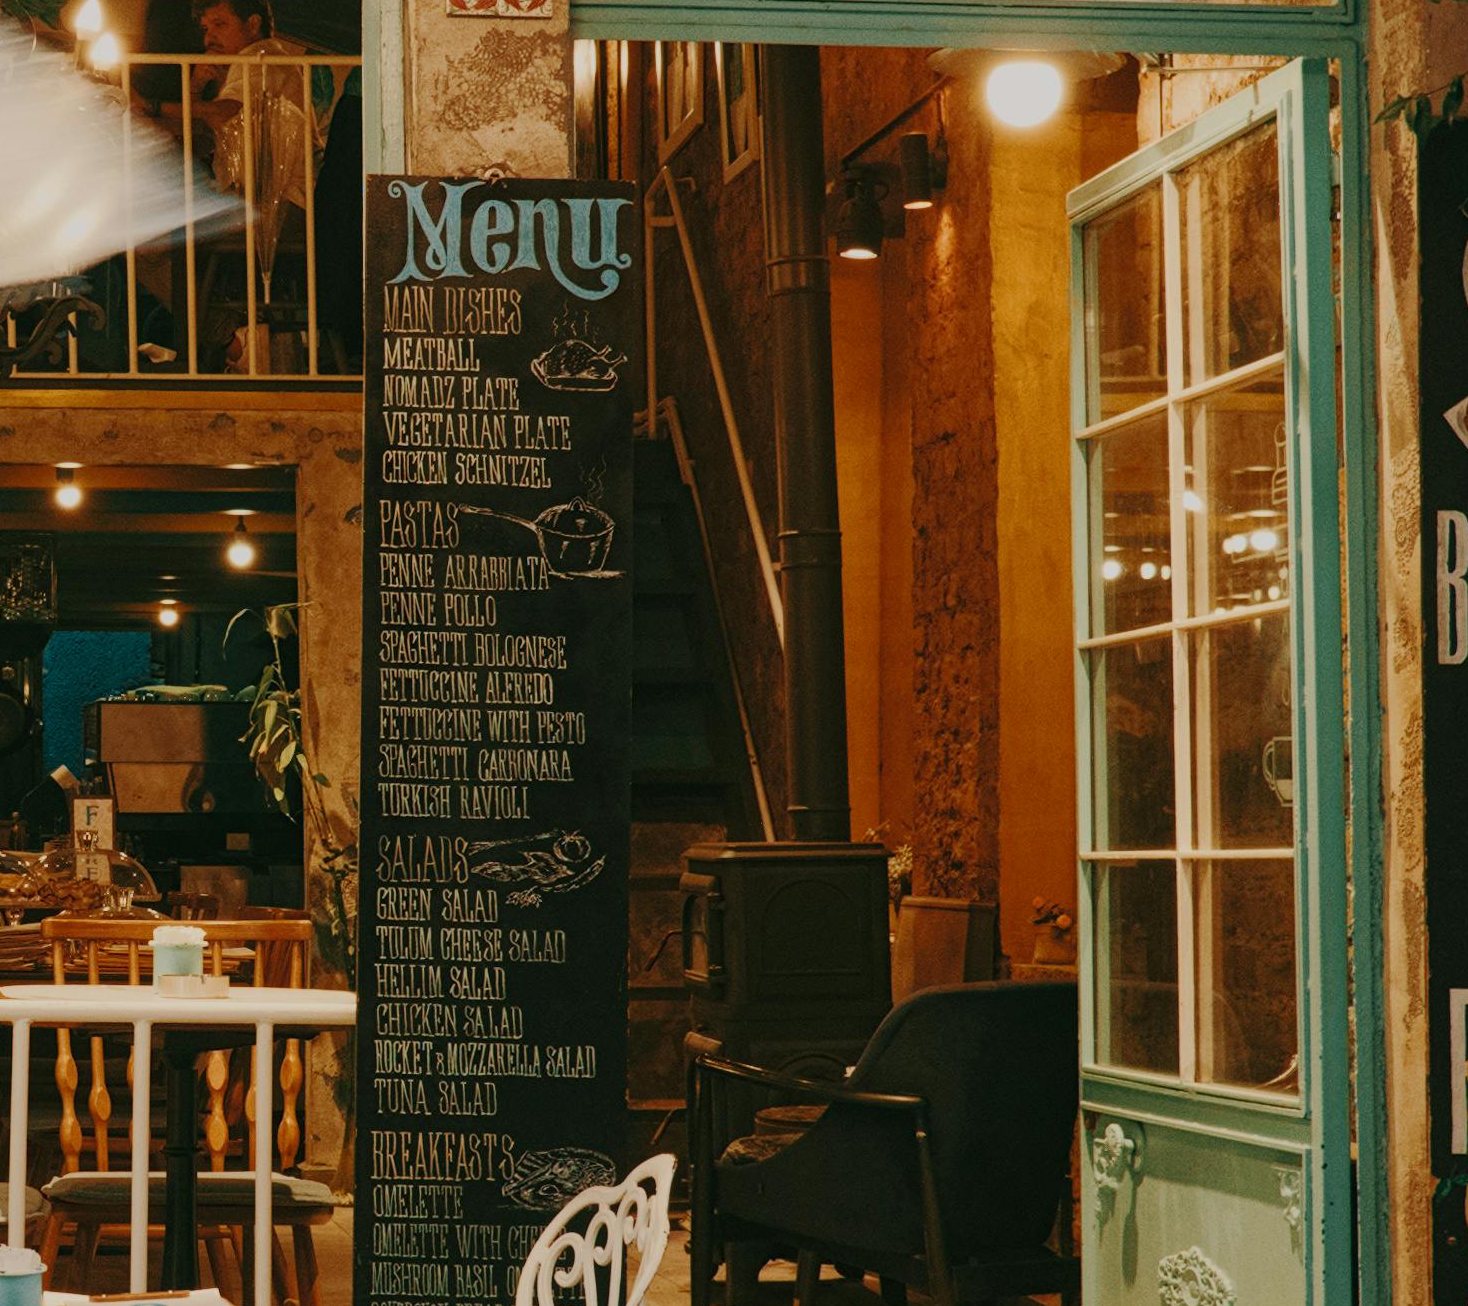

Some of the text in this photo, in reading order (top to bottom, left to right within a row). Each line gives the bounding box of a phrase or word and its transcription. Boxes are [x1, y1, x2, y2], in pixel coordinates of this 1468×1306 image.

[387, 180, 634, 301] Menu
[383, 285, 522, 335] MAIN DISHES
[383, 337, 480, 372] MEATBALL
[383, 375, 520, 411] NOMADZ PLATE
[382, 412, 572, 450] VEGETARIAN PLATE
[382, 450, 552, 489] CHICKEN SCHNITZEL
[379, 499, 460, 549] PASTAS
[379, 552, 550, 591] PENNE ARRABBIATA
[380, 591, 497, 627] PENNE POLLO
[379, 630, 567, 670] SPAGHETTI BOLOGNESE
[378, 667, 554, 705] FETTUCCINE ALFREDO
[378, 705, 586, 745] FETTUCCINE WITH PESTO
[378, 744, 575, 782] SPAGHETTI CARBONARA
[377, 782, 530, 820] TURKISH RAVIOLI
[375, 834, 470, 884] SALADS
[375, 886, 498, 923] GREEN SALAD
[375, 925, 566, 964] TULUM CHEESE SALAD
[374, 963, 507, 1001] HELLIM SALAD
[375, 1002, 523, 1040] CHICKEN SALAD
[374, 1039, 433, 1076] ROCKET
[447, 1042, 542, 1078] MOZZARELLA
[545, 1045, 597, 1079] SALAD
[374, 1078, 498, 1116] TUNA SALAD
[370, 1130, 515, 1182] BREAKFASTS
[373, 1184, 463, 1220] OMELETTE
[372, 1223, 449, 1258] OMELETTE
[455, 1223, 502, 1260] WITH
[370, 1261, 449, 1297] MUSHROOM
[455, 1263, 498, 1298] BASIL
